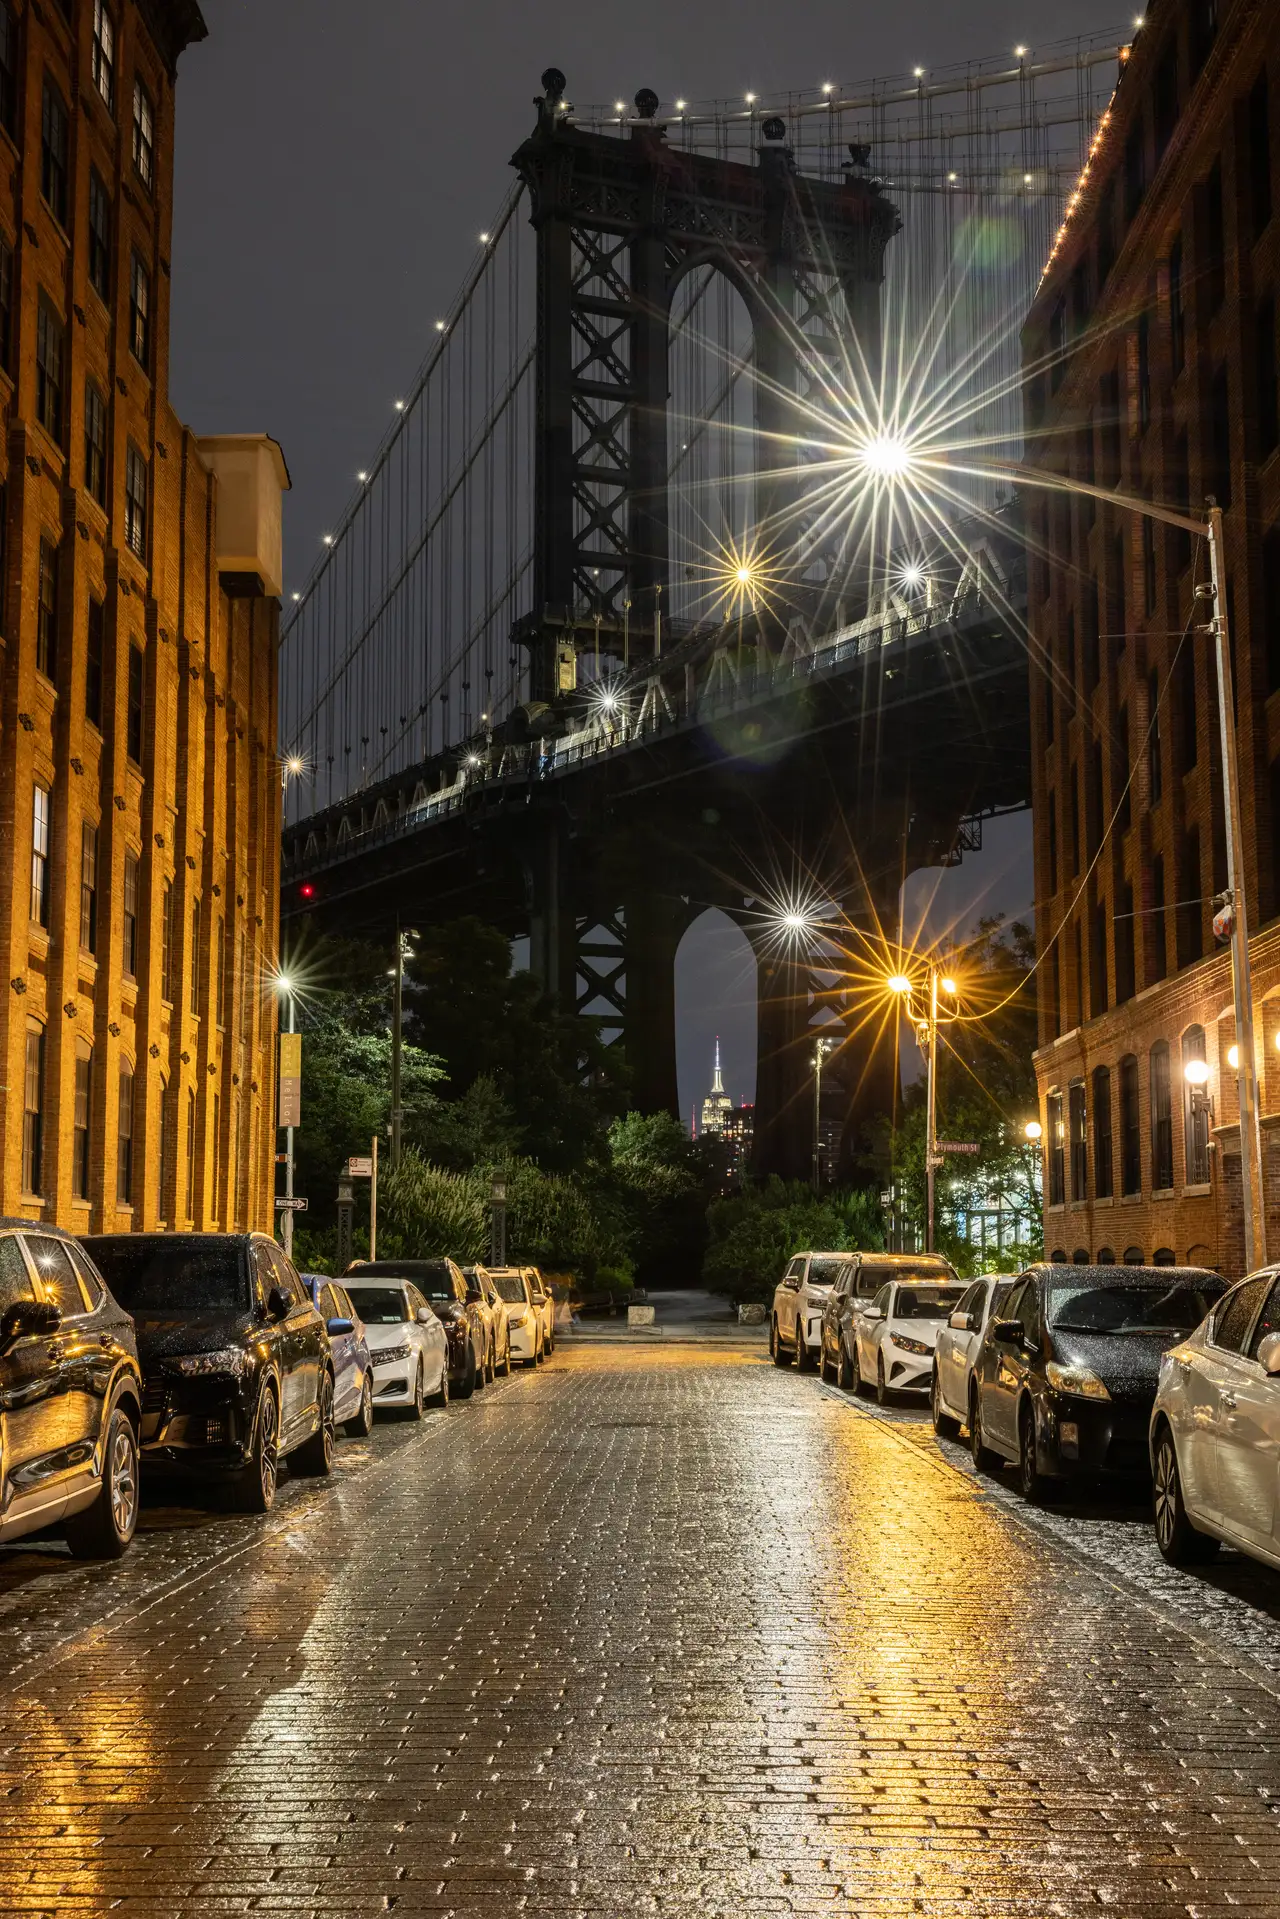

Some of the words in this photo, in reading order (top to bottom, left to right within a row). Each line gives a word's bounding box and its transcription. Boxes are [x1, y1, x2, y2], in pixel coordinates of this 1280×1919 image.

[284, 1079, 293, 1124] Mellon
[936, 1143, 969, 1152] Plymouth
[970, 1144, 977, 1152] St
